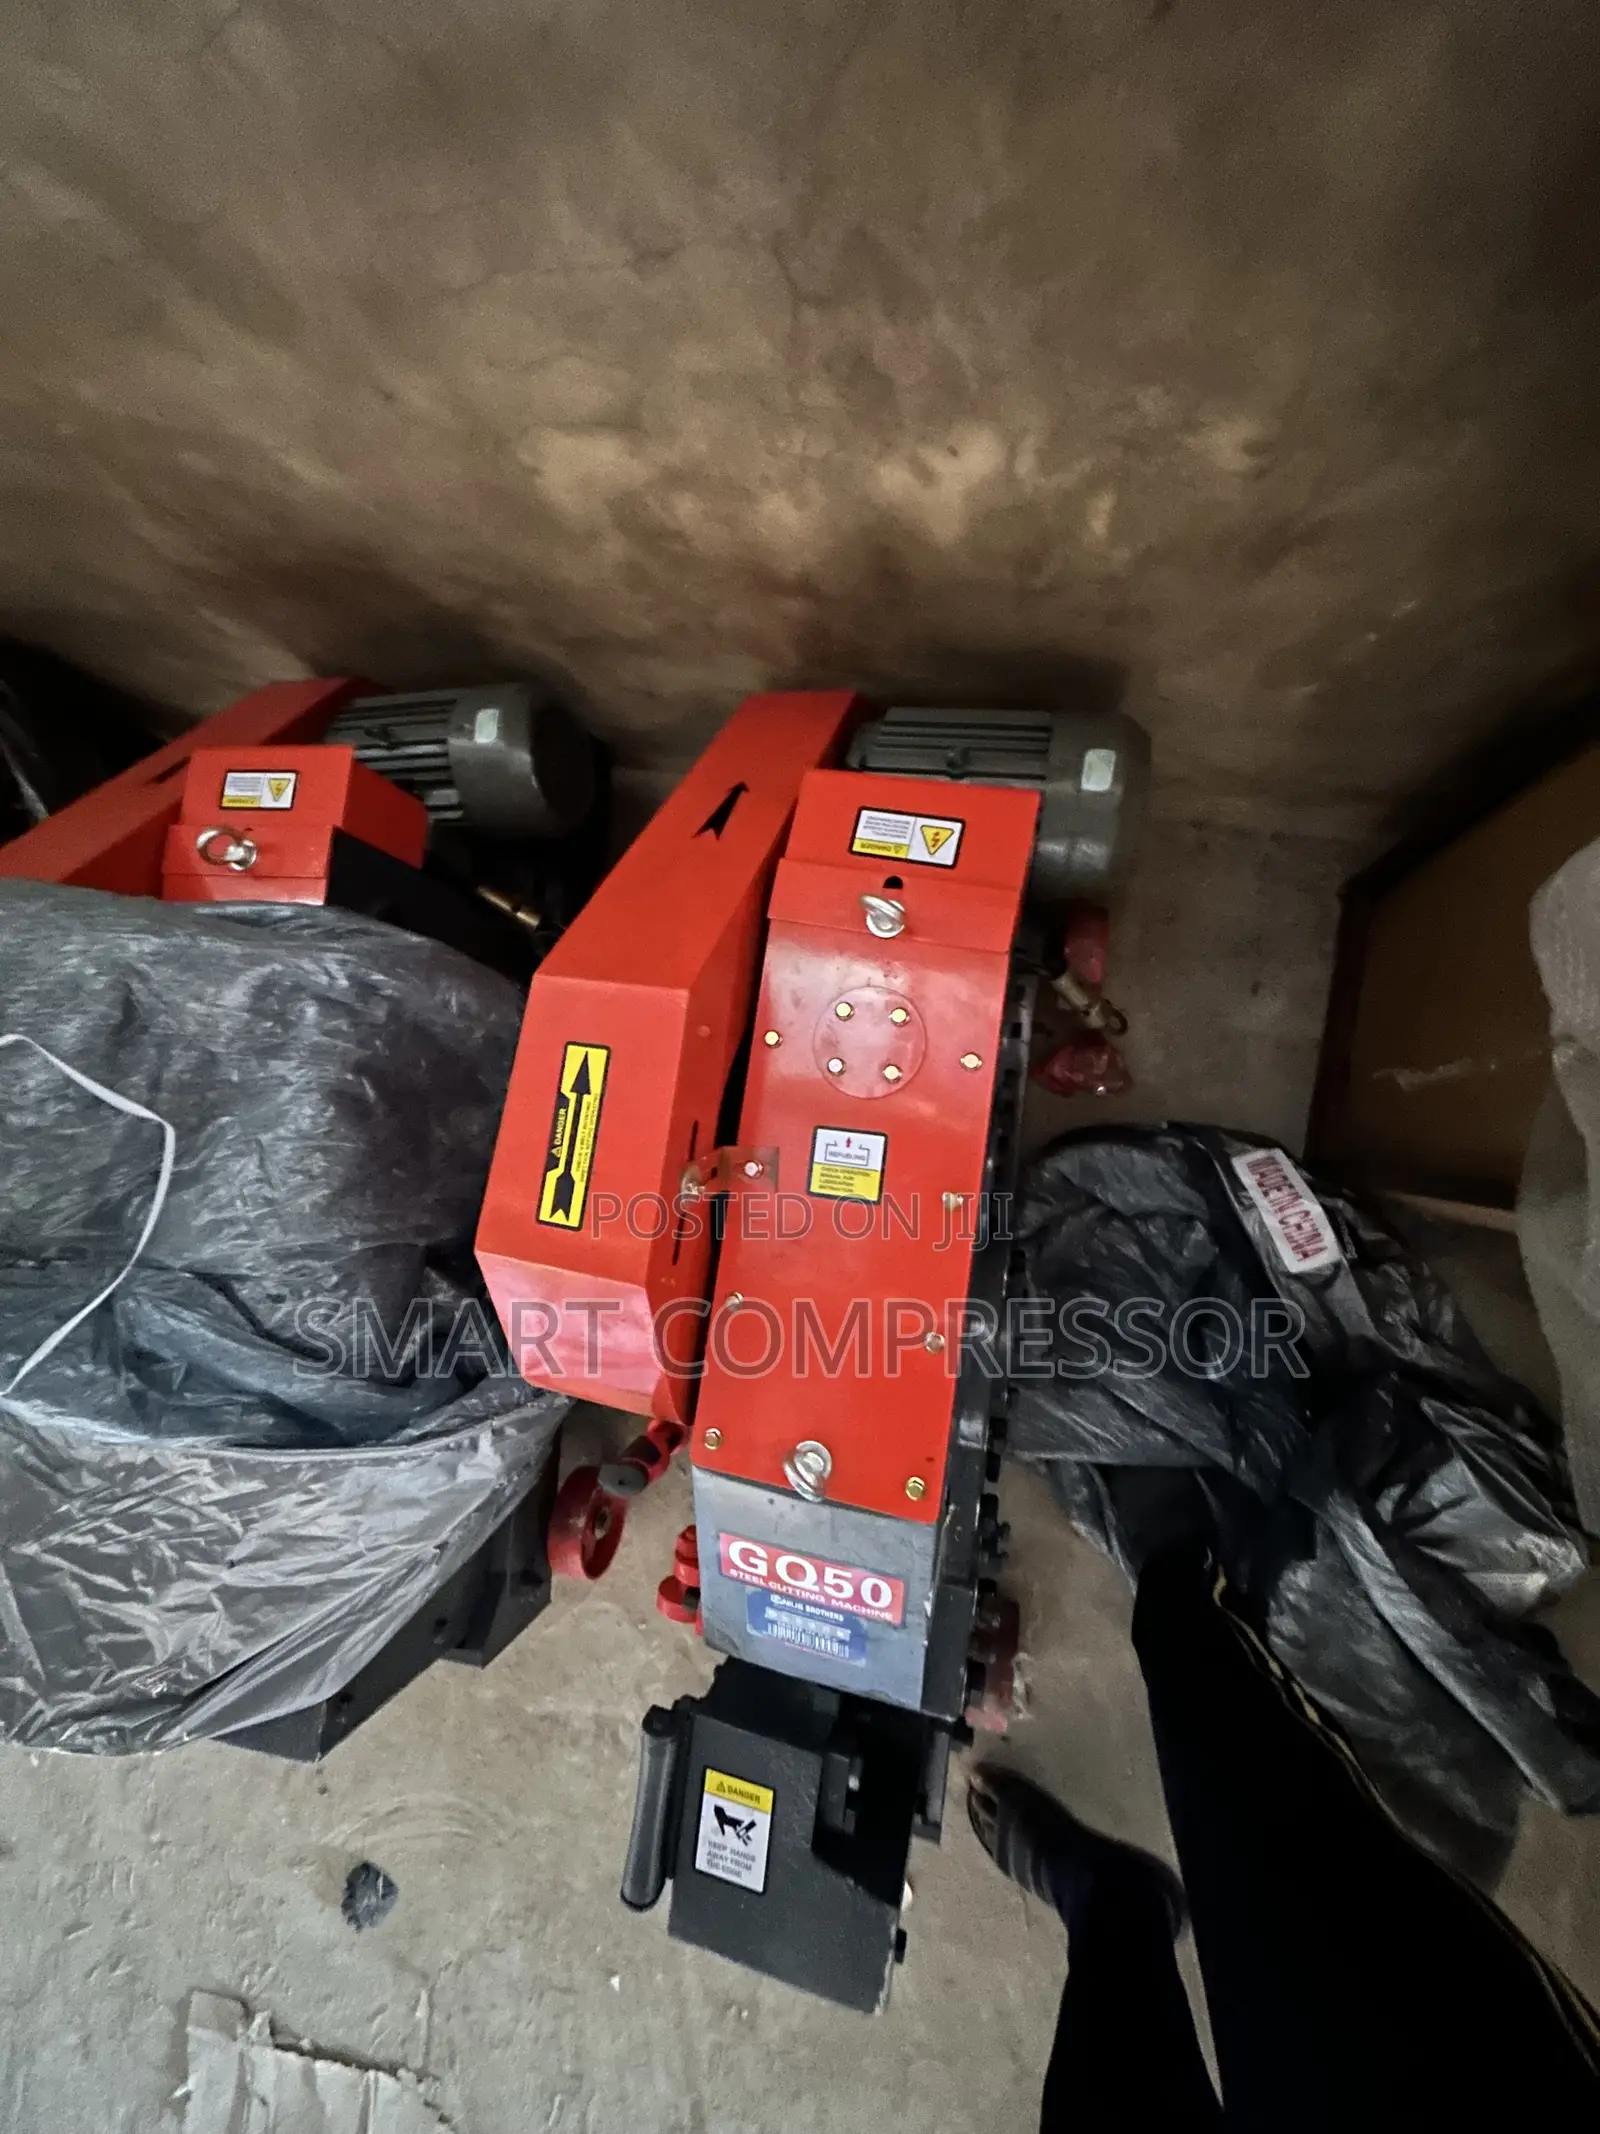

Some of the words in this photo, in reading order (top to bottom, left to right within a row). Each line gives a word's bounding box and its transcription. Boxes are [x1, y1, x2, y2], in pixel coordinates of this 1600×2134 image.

[554, 1108, 567, 1145] DANGER
[1246, 1155, 1297, 1198] MADE
[1267, 1191, 1304, 1214] IN
[1278, 1209, 1329, 1262] CHINA
[728, 1540, 893, 1609] GQ50
[729, 1568, 768, 1588] STEEL
[768, 1581, 828, 1606] CUTTING
[831, 1598, 893, 1621] MACHINE
[804, 1603, 845, 1622] BROTHERS
[727, 1786, 761, 1804] DANGER
